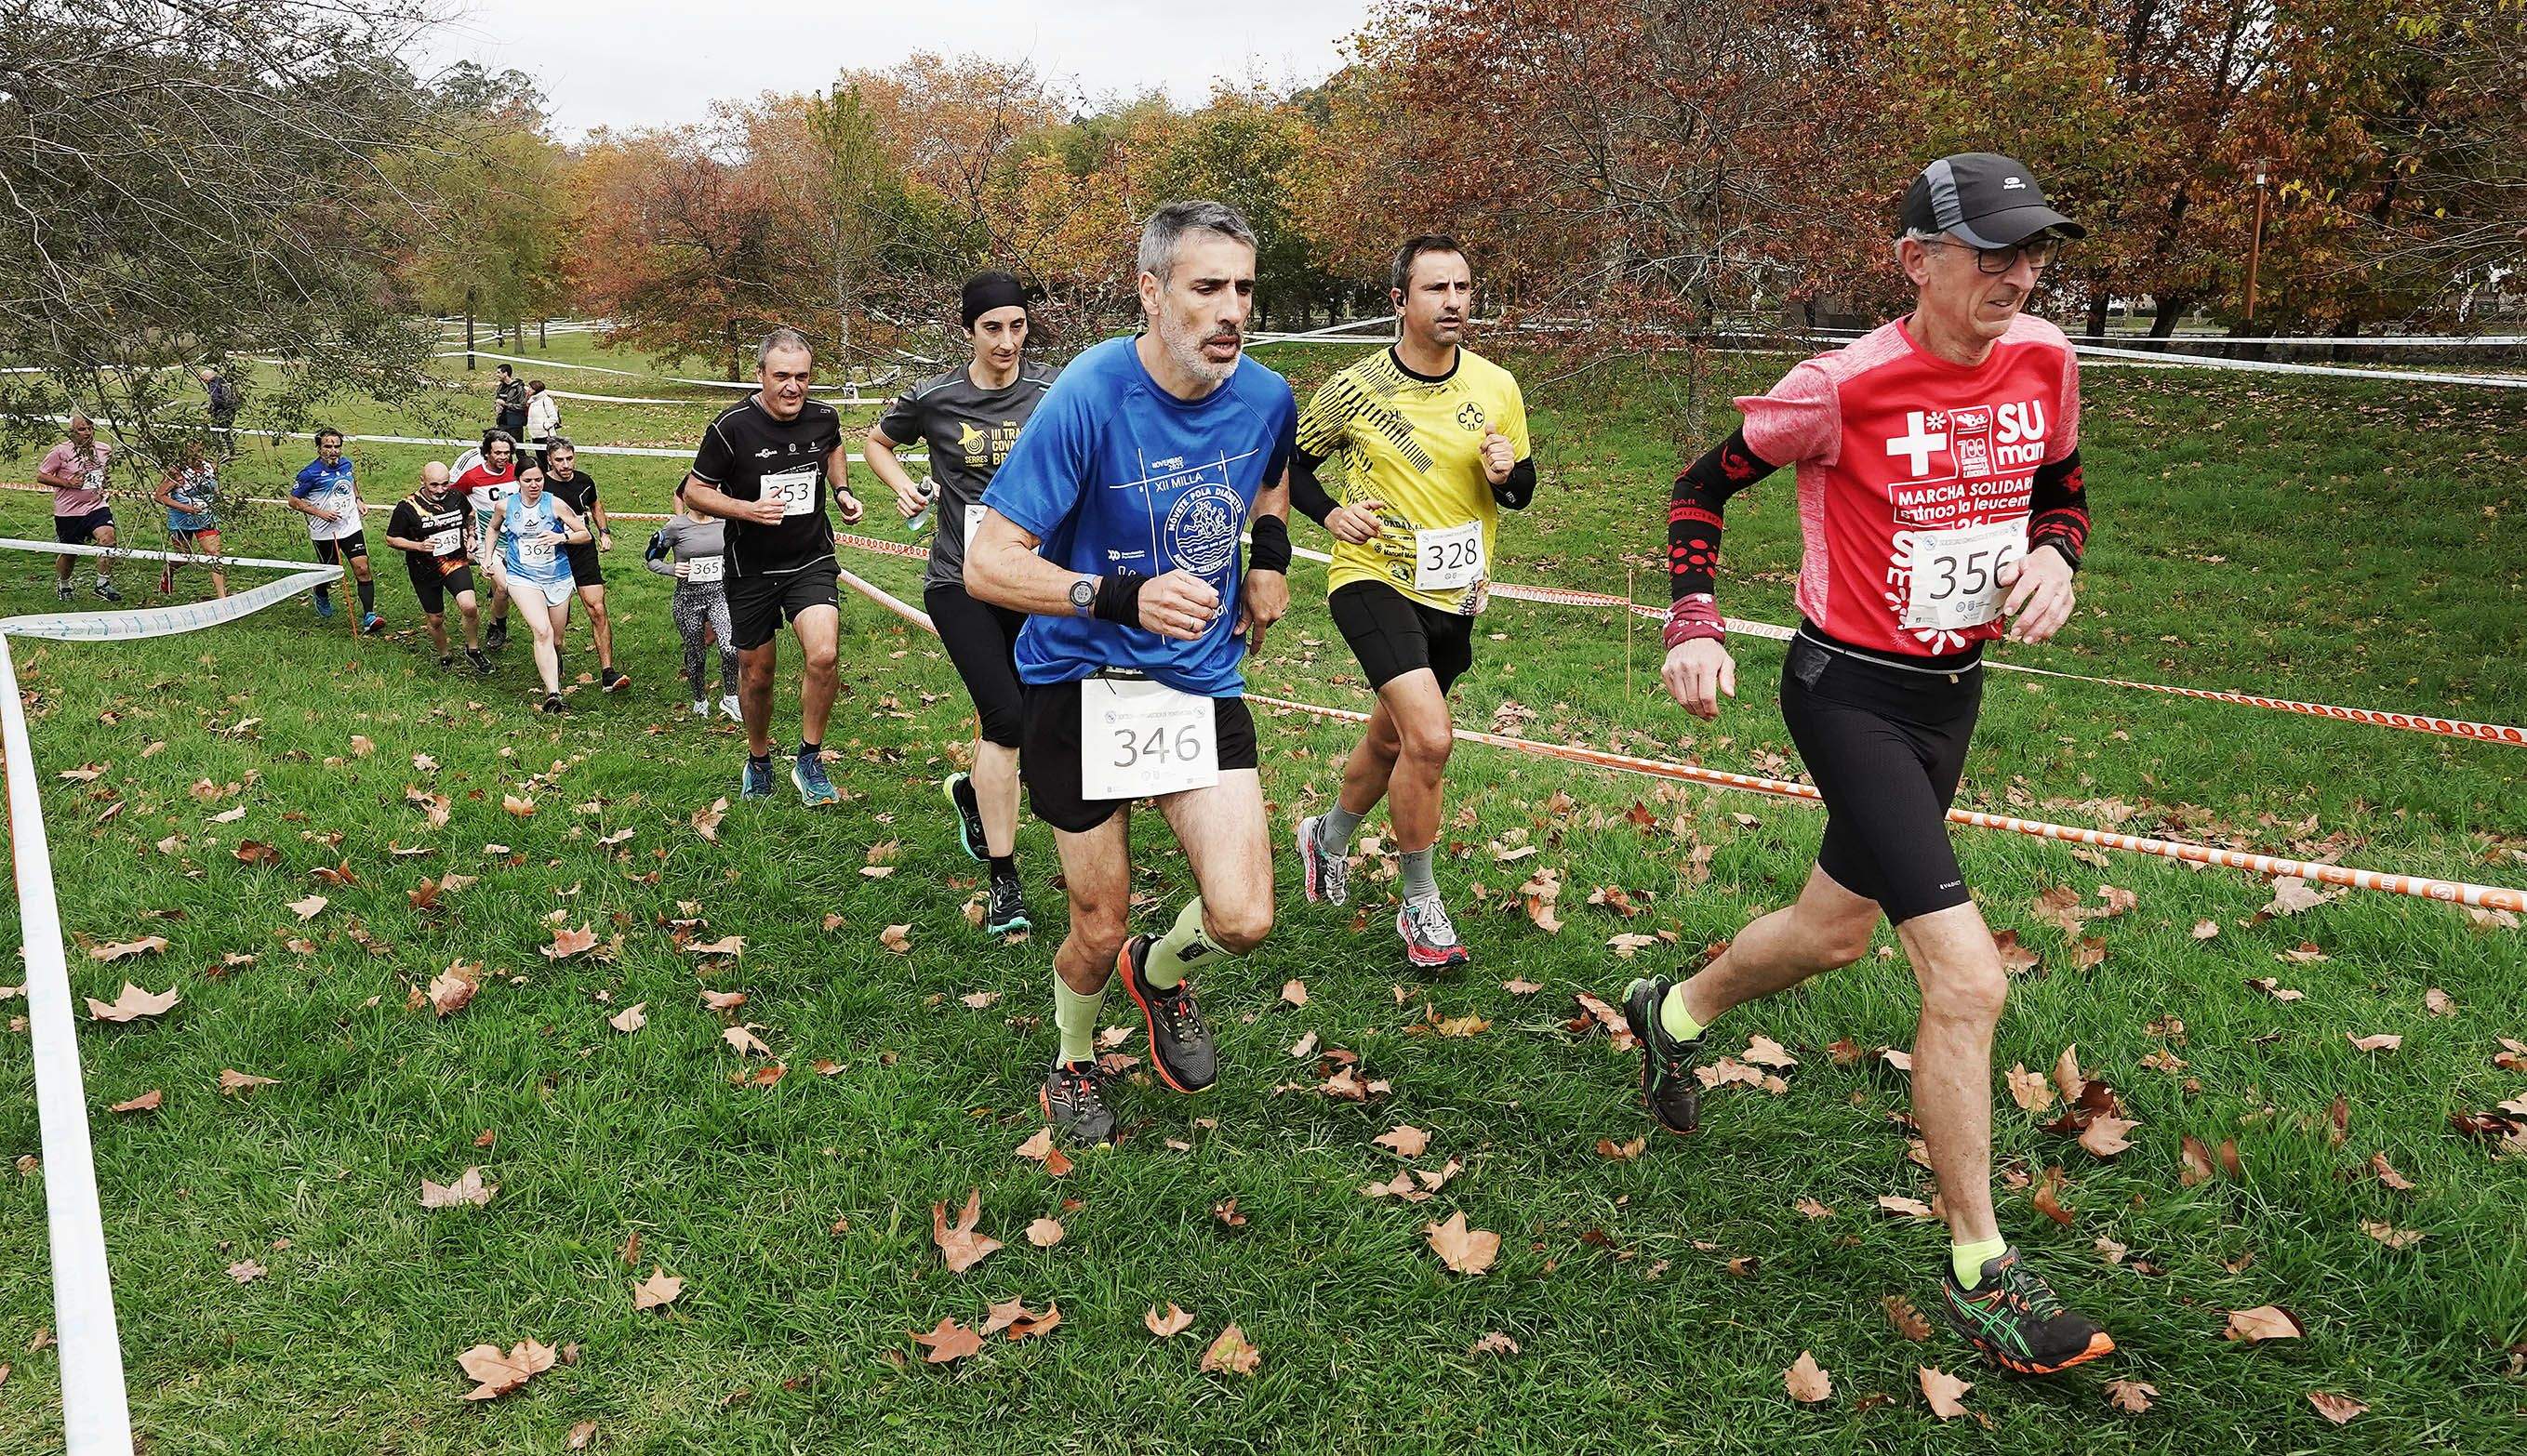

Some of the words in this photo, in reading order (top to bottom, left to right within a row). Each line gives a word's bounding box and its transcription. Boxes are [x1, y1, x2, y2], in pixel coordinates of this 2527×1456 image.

[1996, 400, 2044, 443] SU
[964, 455, 989, 464] SERRES
[1996, 441, 2045, 466] man
[1171, 471, 1204, 489] MILLA
[1190, 487, 1212, 501] POLA
[1215, 487, 1244, 514] DIABETES
[1898, 483, 1965, 507] MARCHA
[524, 544, 552, 556] 362
[1426, 537, 1478, 571] 328
[693, 562, 719, 575] 365
[1929, 544, 2013, 600] 356
[1113, 724, 1202, 768] 346
